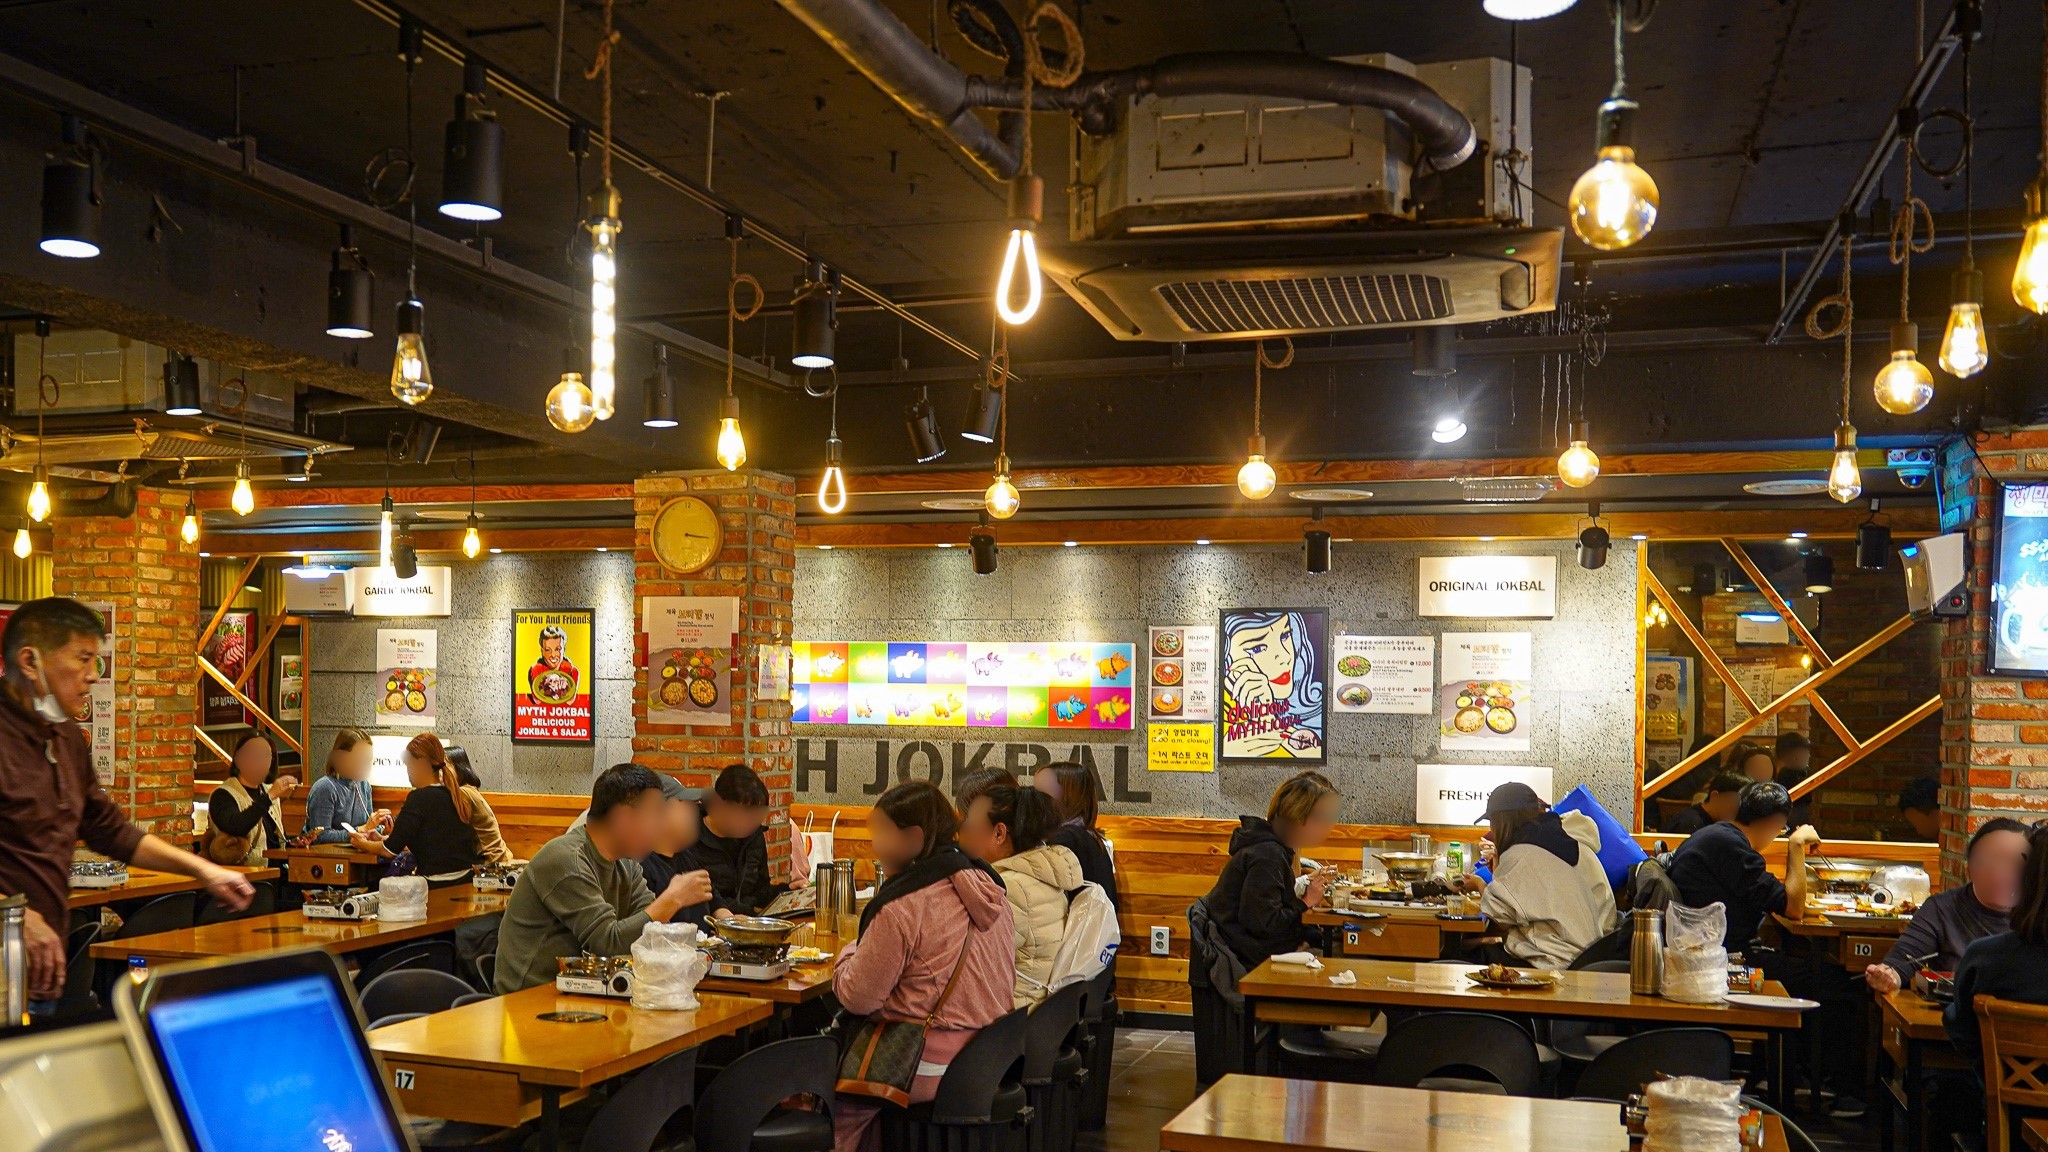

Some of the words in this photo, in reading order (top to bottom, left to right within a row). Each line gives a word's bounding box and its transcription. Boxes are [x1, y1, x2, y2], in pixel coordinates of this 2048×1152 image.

[1429, 581, 1488, 592] ORIGINAL
[1494, 580, 1546, 592] JOKBAL
[516, 614, 527, 624] For
[530, 615, 542, 624] You
[546, 615, 560, 624] And
[562, 614, 591, 624] Friends
[518, 706, 546, 716] MYTH
[550, 708, 590, 717] JOKBAL
[1228, 698, 1290, 723] delicious
[532, 718, 575, 726] DELICIOUS
[518, 728, 550, 736] JOKBAL
[560, 728, 587, 736] SALAD
[1228, 719, 1267, 742] MYTH
[1440, 790, 1482, 800] FRESH
[337, 864, 342, 873] 6
[1350, 934, 1356, 944] 9
[1856, 944, 1870, 955] 10
[397, 1072, 414, 1088] 17
